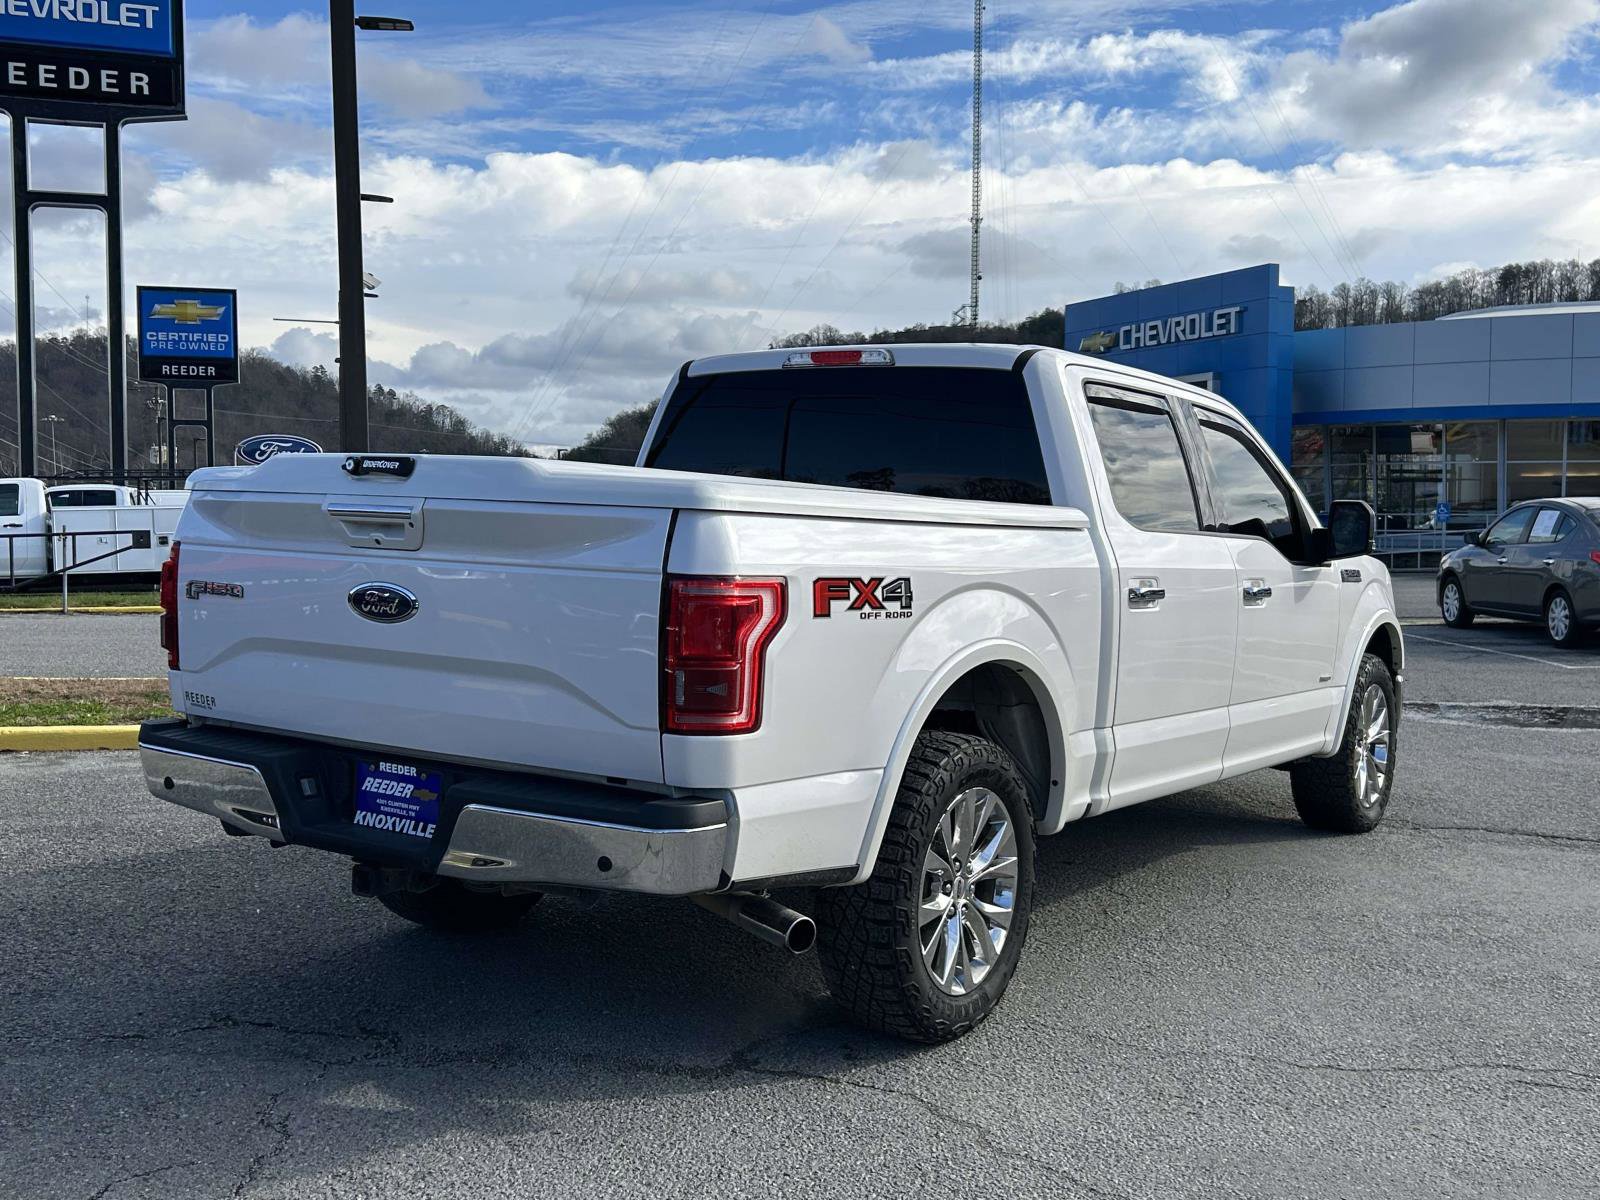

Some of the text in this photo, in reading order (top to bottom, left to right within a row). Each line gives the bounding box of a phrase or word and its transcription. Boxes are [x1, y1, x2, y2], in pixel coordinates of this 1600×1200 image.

[8, 62, 149, 95] EEDER
[146, 332, 229, 342] CERTIFIED
[1119, 306, 1241, 350] CHEVROLET
[150, 341, 225, 351] PRE-OWNED
[162, 365, 216, 376] REEDER
[361, 590, 399, 614] Ford
[813, 577, 913, 618] FX4
[860, 611, 912, 620] OFF ROAD
[184, 691, 217, 707] REEDER
[379, 762, 417, 777] REEDER
[361, 777, 415, 799] REEDER
[353, 810, 437, 839] KNOXVILLE
